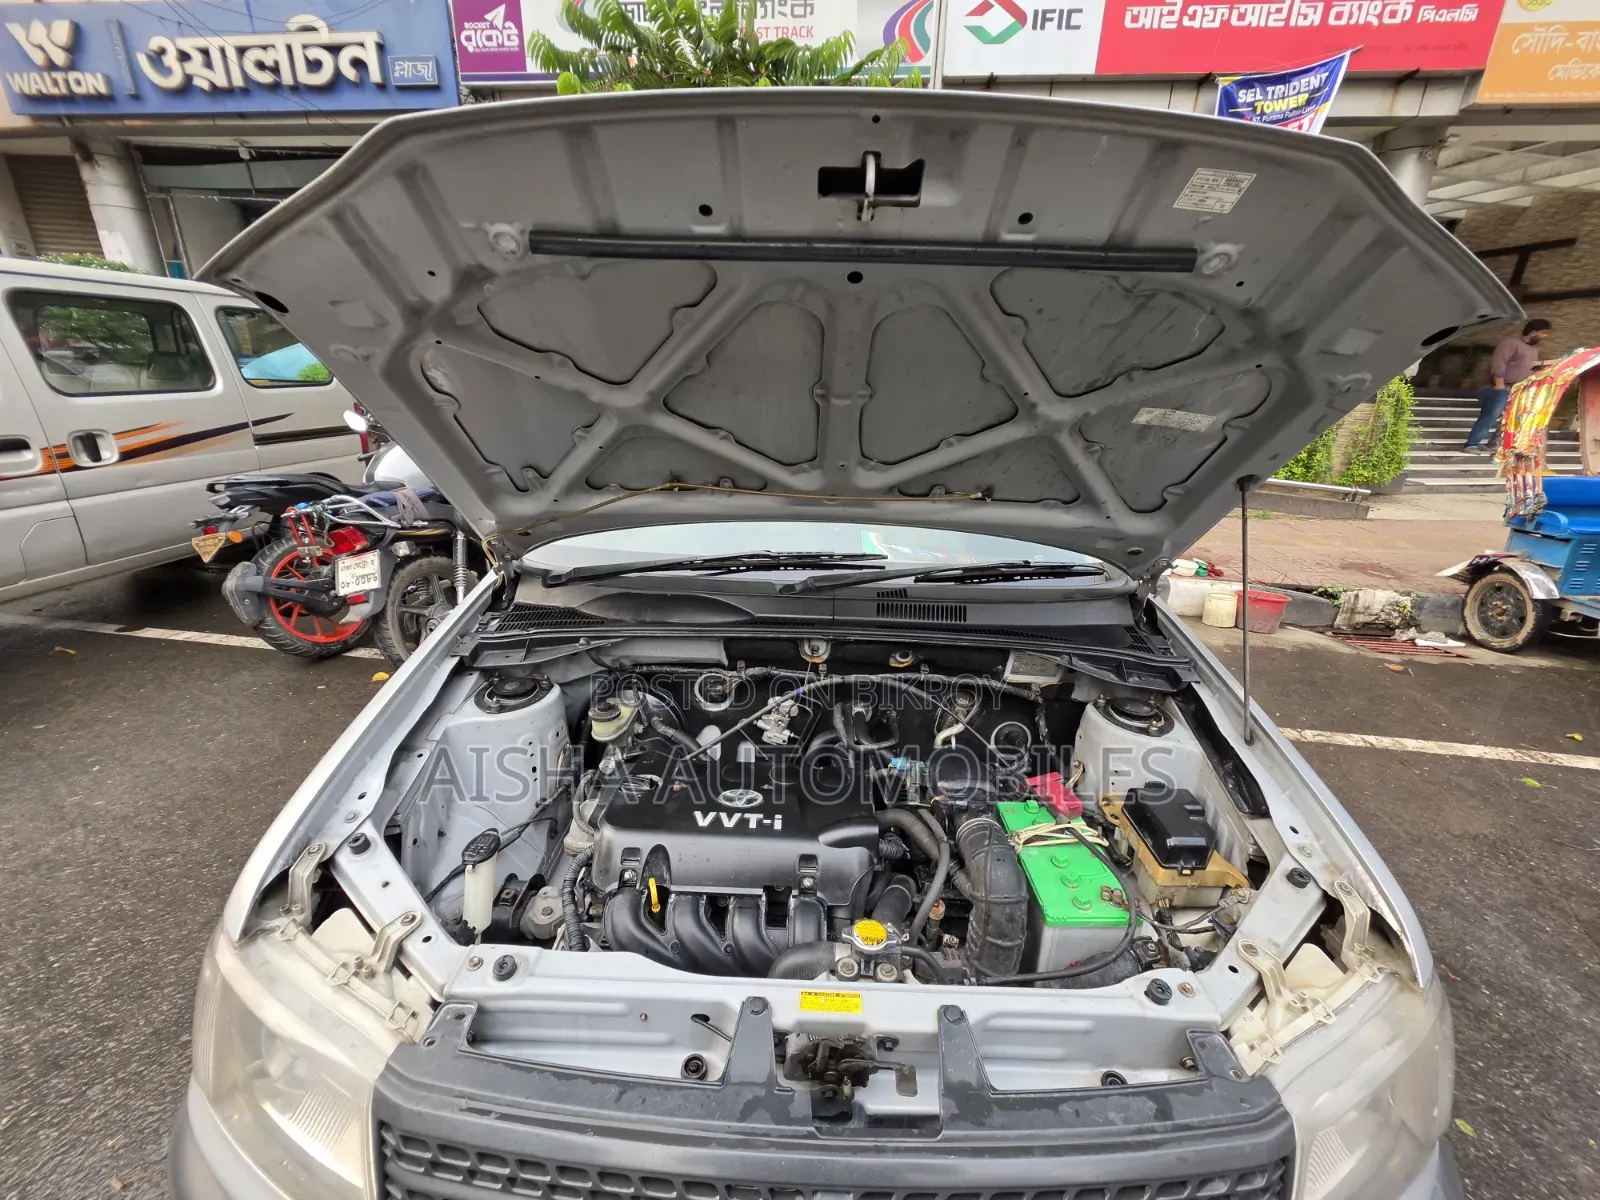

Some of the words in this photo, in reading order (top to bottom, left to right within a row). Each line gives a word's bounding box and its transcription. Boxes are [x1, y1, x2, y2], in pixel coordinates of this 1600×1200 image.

[1031, 8, 1083, 30] IFIC
[1328, 0, 1416, 27] ব্যাংক
[1416, 4, 1479, 23] পিএলসি
[463, 21, 491, 29] ROCKET
[773, 25, 814, 39] TRACK
[136, 14, 383, 91] ওয়ালটন
[5, 71, 109, 96] WALTON
[1238, 87, 1264, 103] SEL
[1266, 72, 1329, 98] TRIDENT
[1254, 93, 1310, 115] TOWER
[693, 811, 783, 830] VVT-i
